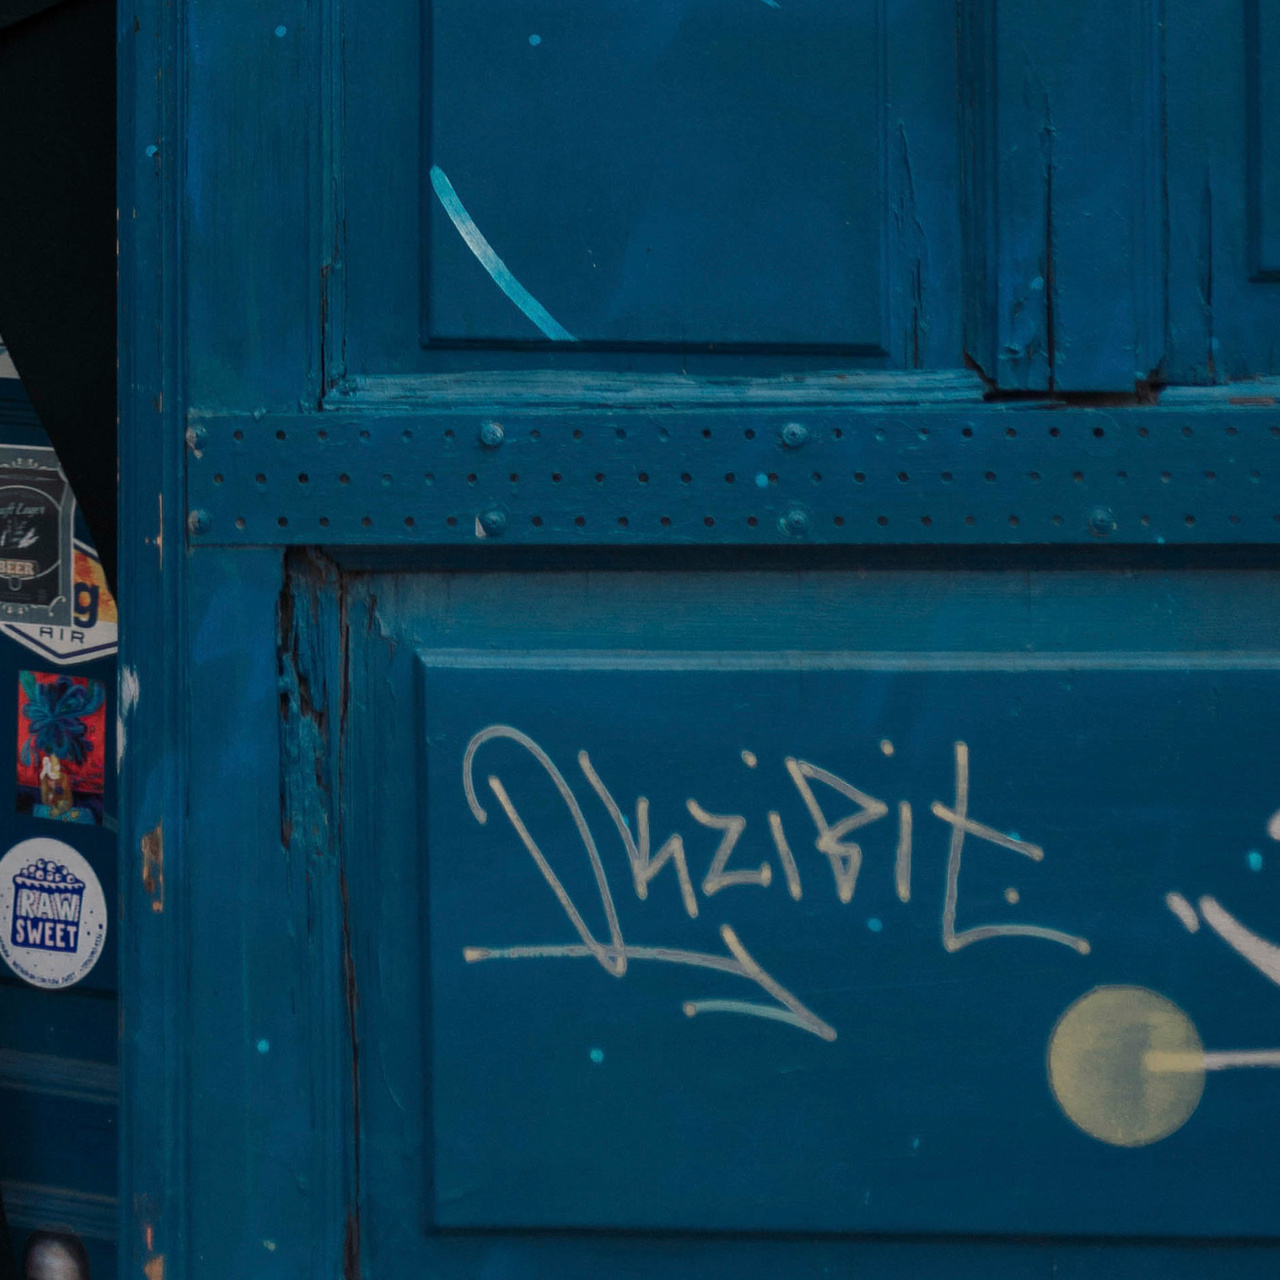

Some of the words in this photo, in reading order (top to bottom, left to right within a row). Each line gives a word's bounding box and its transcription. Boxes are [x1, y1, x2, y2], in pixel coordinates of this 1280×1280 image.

[40, 626, 85, 644] AIR
[20, 888, 78, 923] RAW
[15, 918, 77, 948] SWEET
